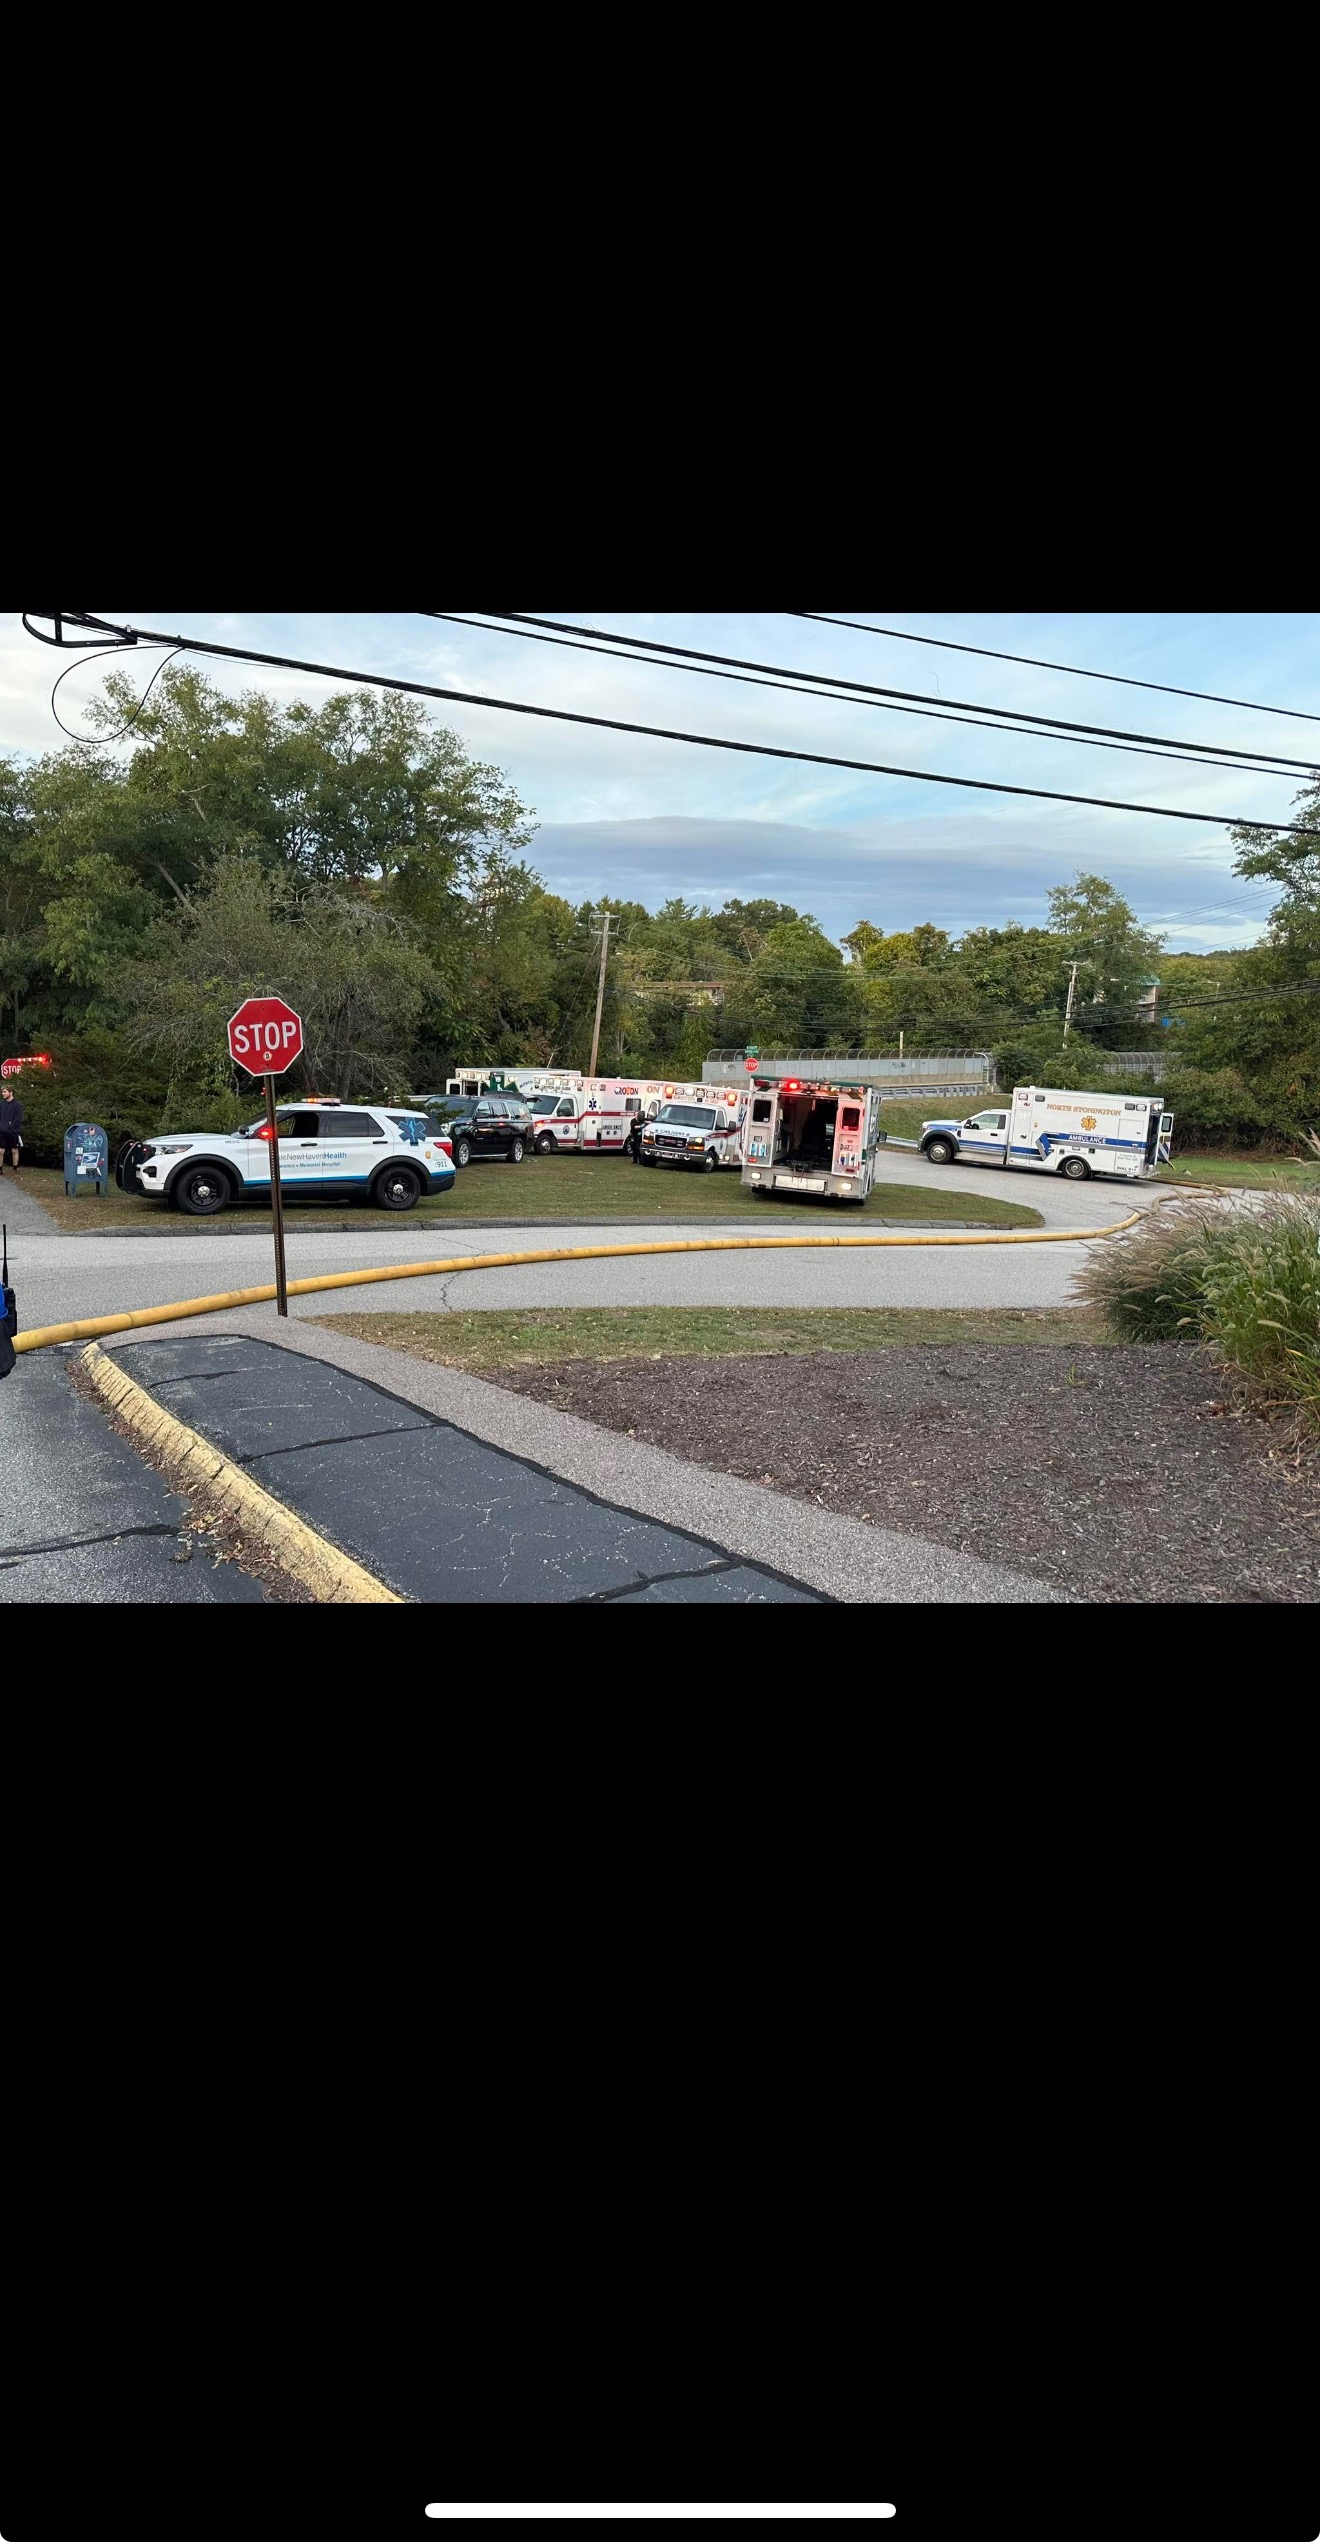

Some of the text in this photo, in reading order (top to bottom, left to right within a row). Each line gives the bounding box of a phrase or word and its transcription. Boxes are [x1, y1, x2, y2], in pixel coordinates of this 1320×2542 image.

[234, 1021, 297, 1053] STOP
[3, 1065, 22, 1075] STOP
[614, 1087, 639, 1096] GROTON
[1046, 1103, 1122, 1116] NORTH STONINGTON
[1069, 1135, 1106, 1144] AMBULANCE
[279, 1152, 347, 1161] leNewHavenHealth
